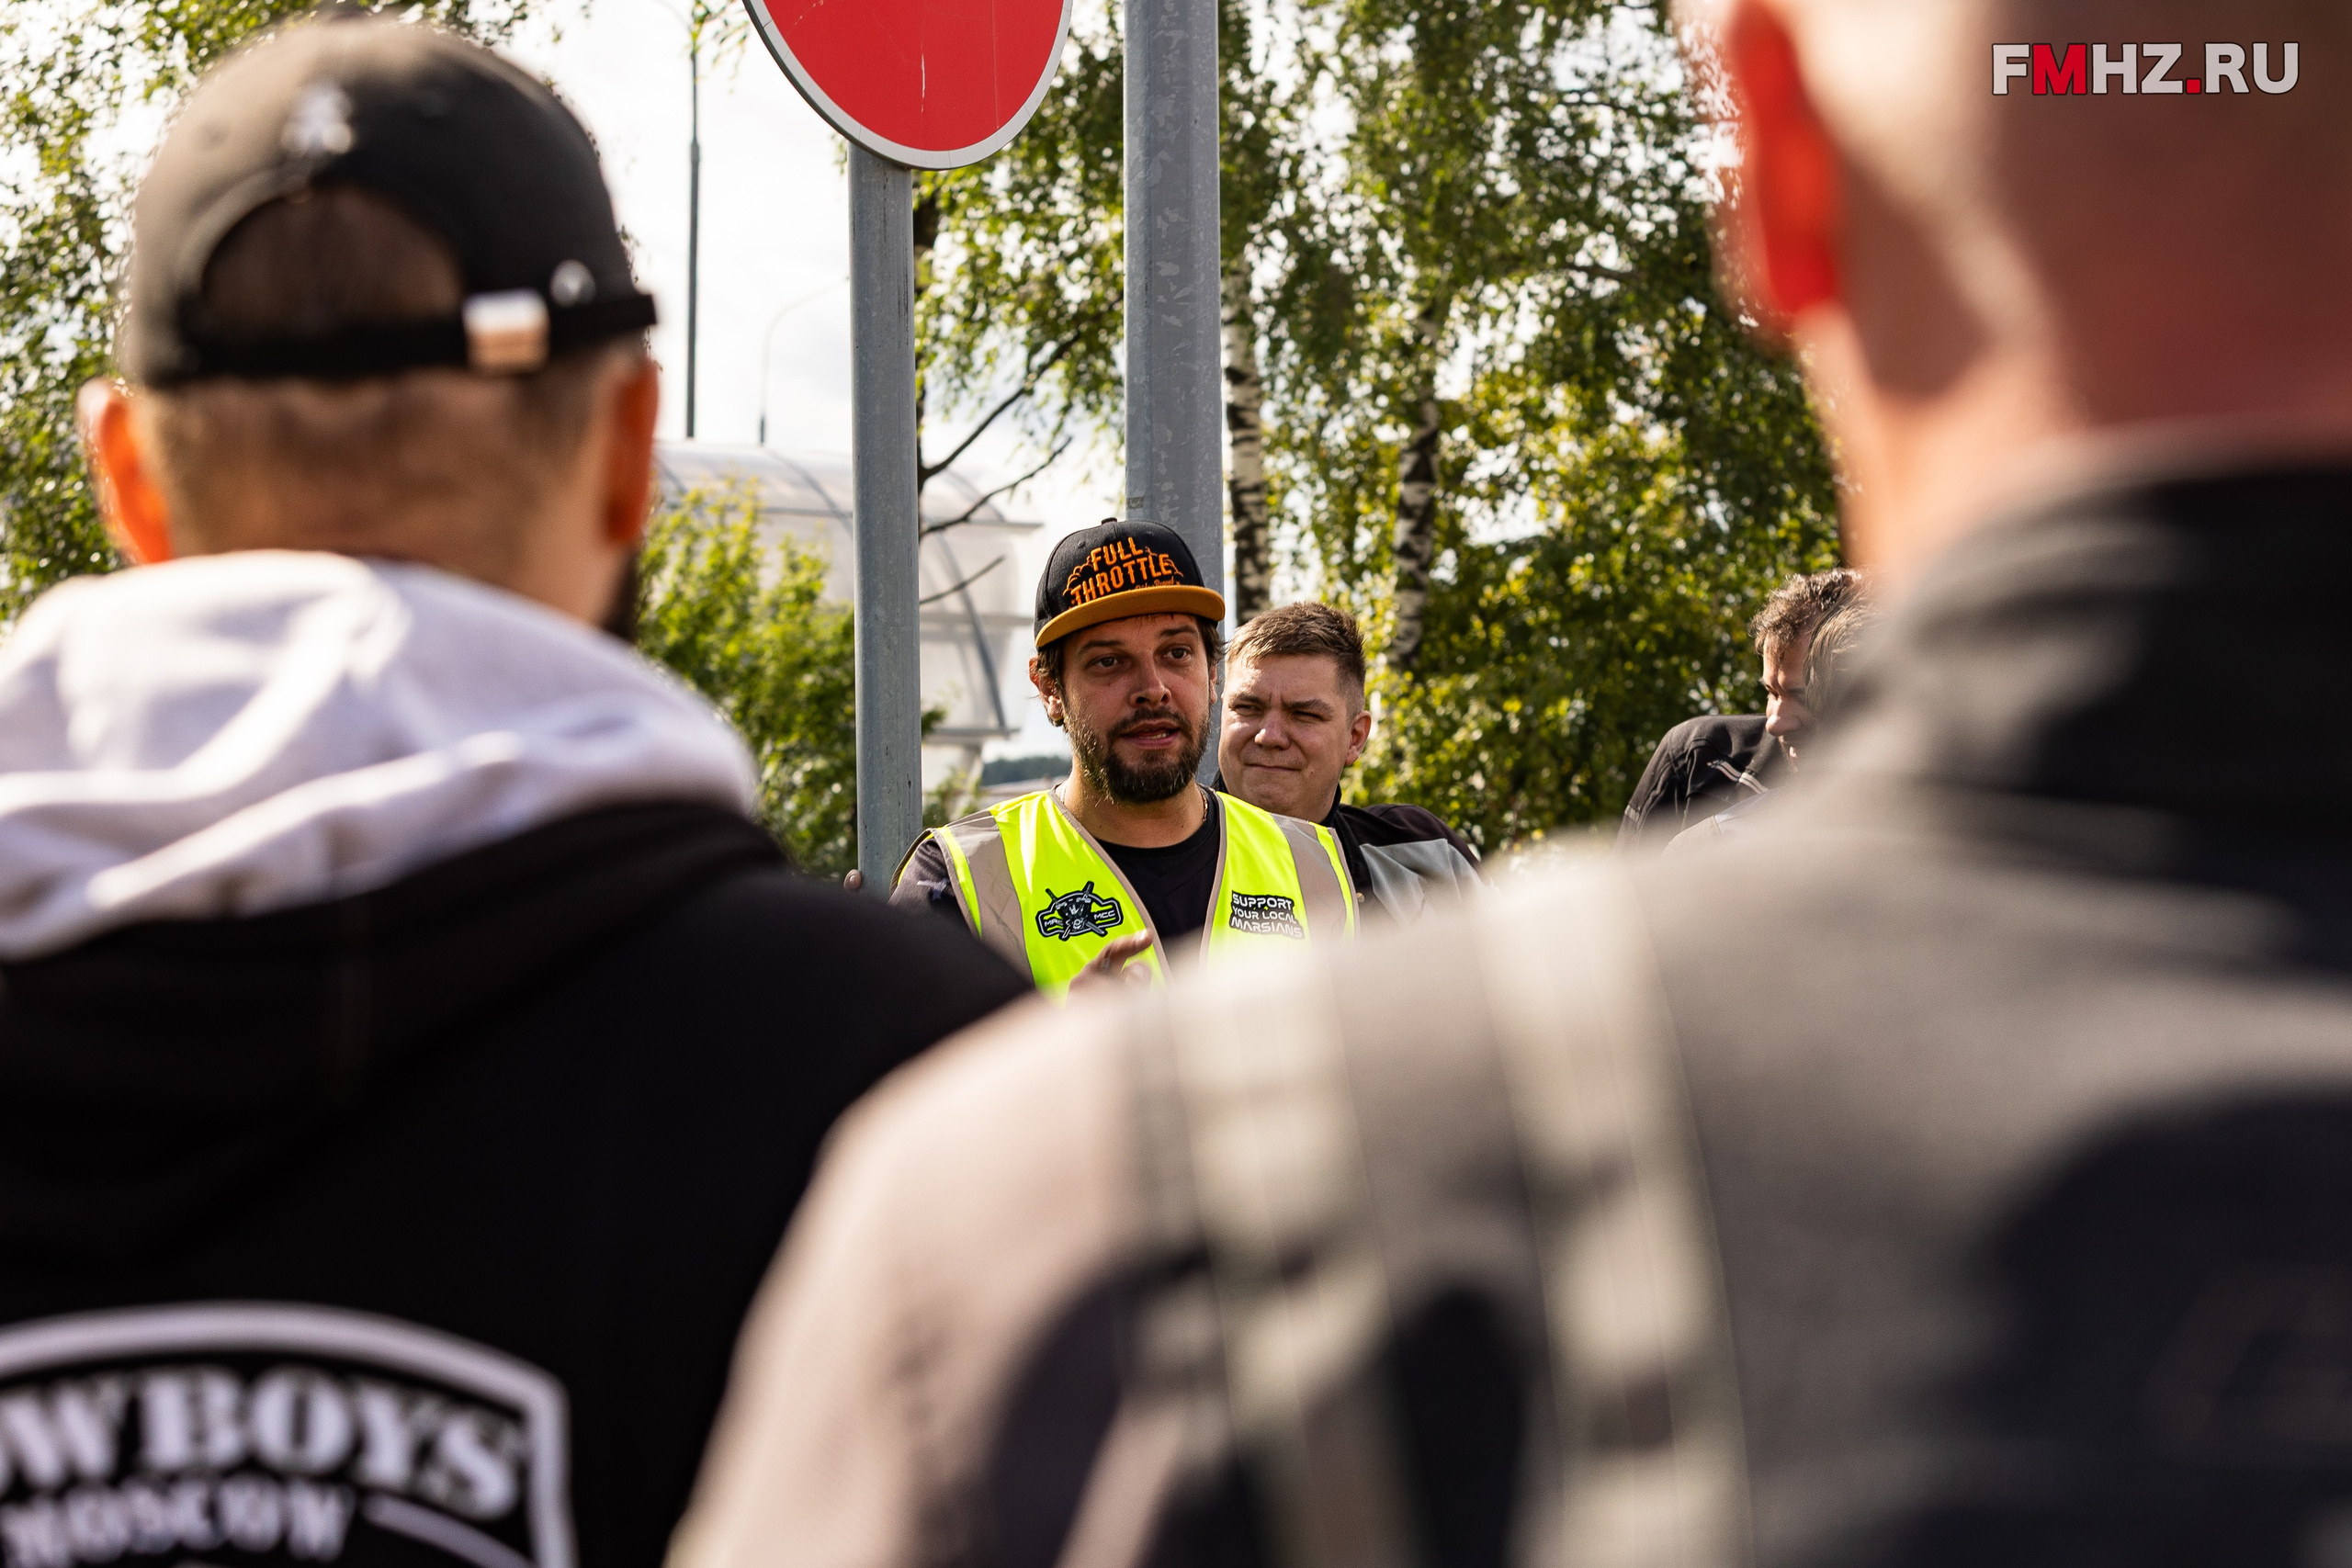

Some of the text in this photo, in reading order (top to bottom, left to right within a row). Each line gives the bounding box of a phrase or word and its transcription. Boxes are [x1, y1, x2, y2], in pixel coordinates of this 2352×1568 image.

[1091, 536, 1144, 571] FULL
[1070, 553, 1172, 606] THROTTLE
[1232, 893, 1292, 911] SUPPORT
[1093, 909, 1116, 920] MCC
[1232, 905, 1297, 925] YOUR LOCAL
[1230, 916, 1303, 938] MARSIANS
[0, 1367, 531, 1521] WBOYS
